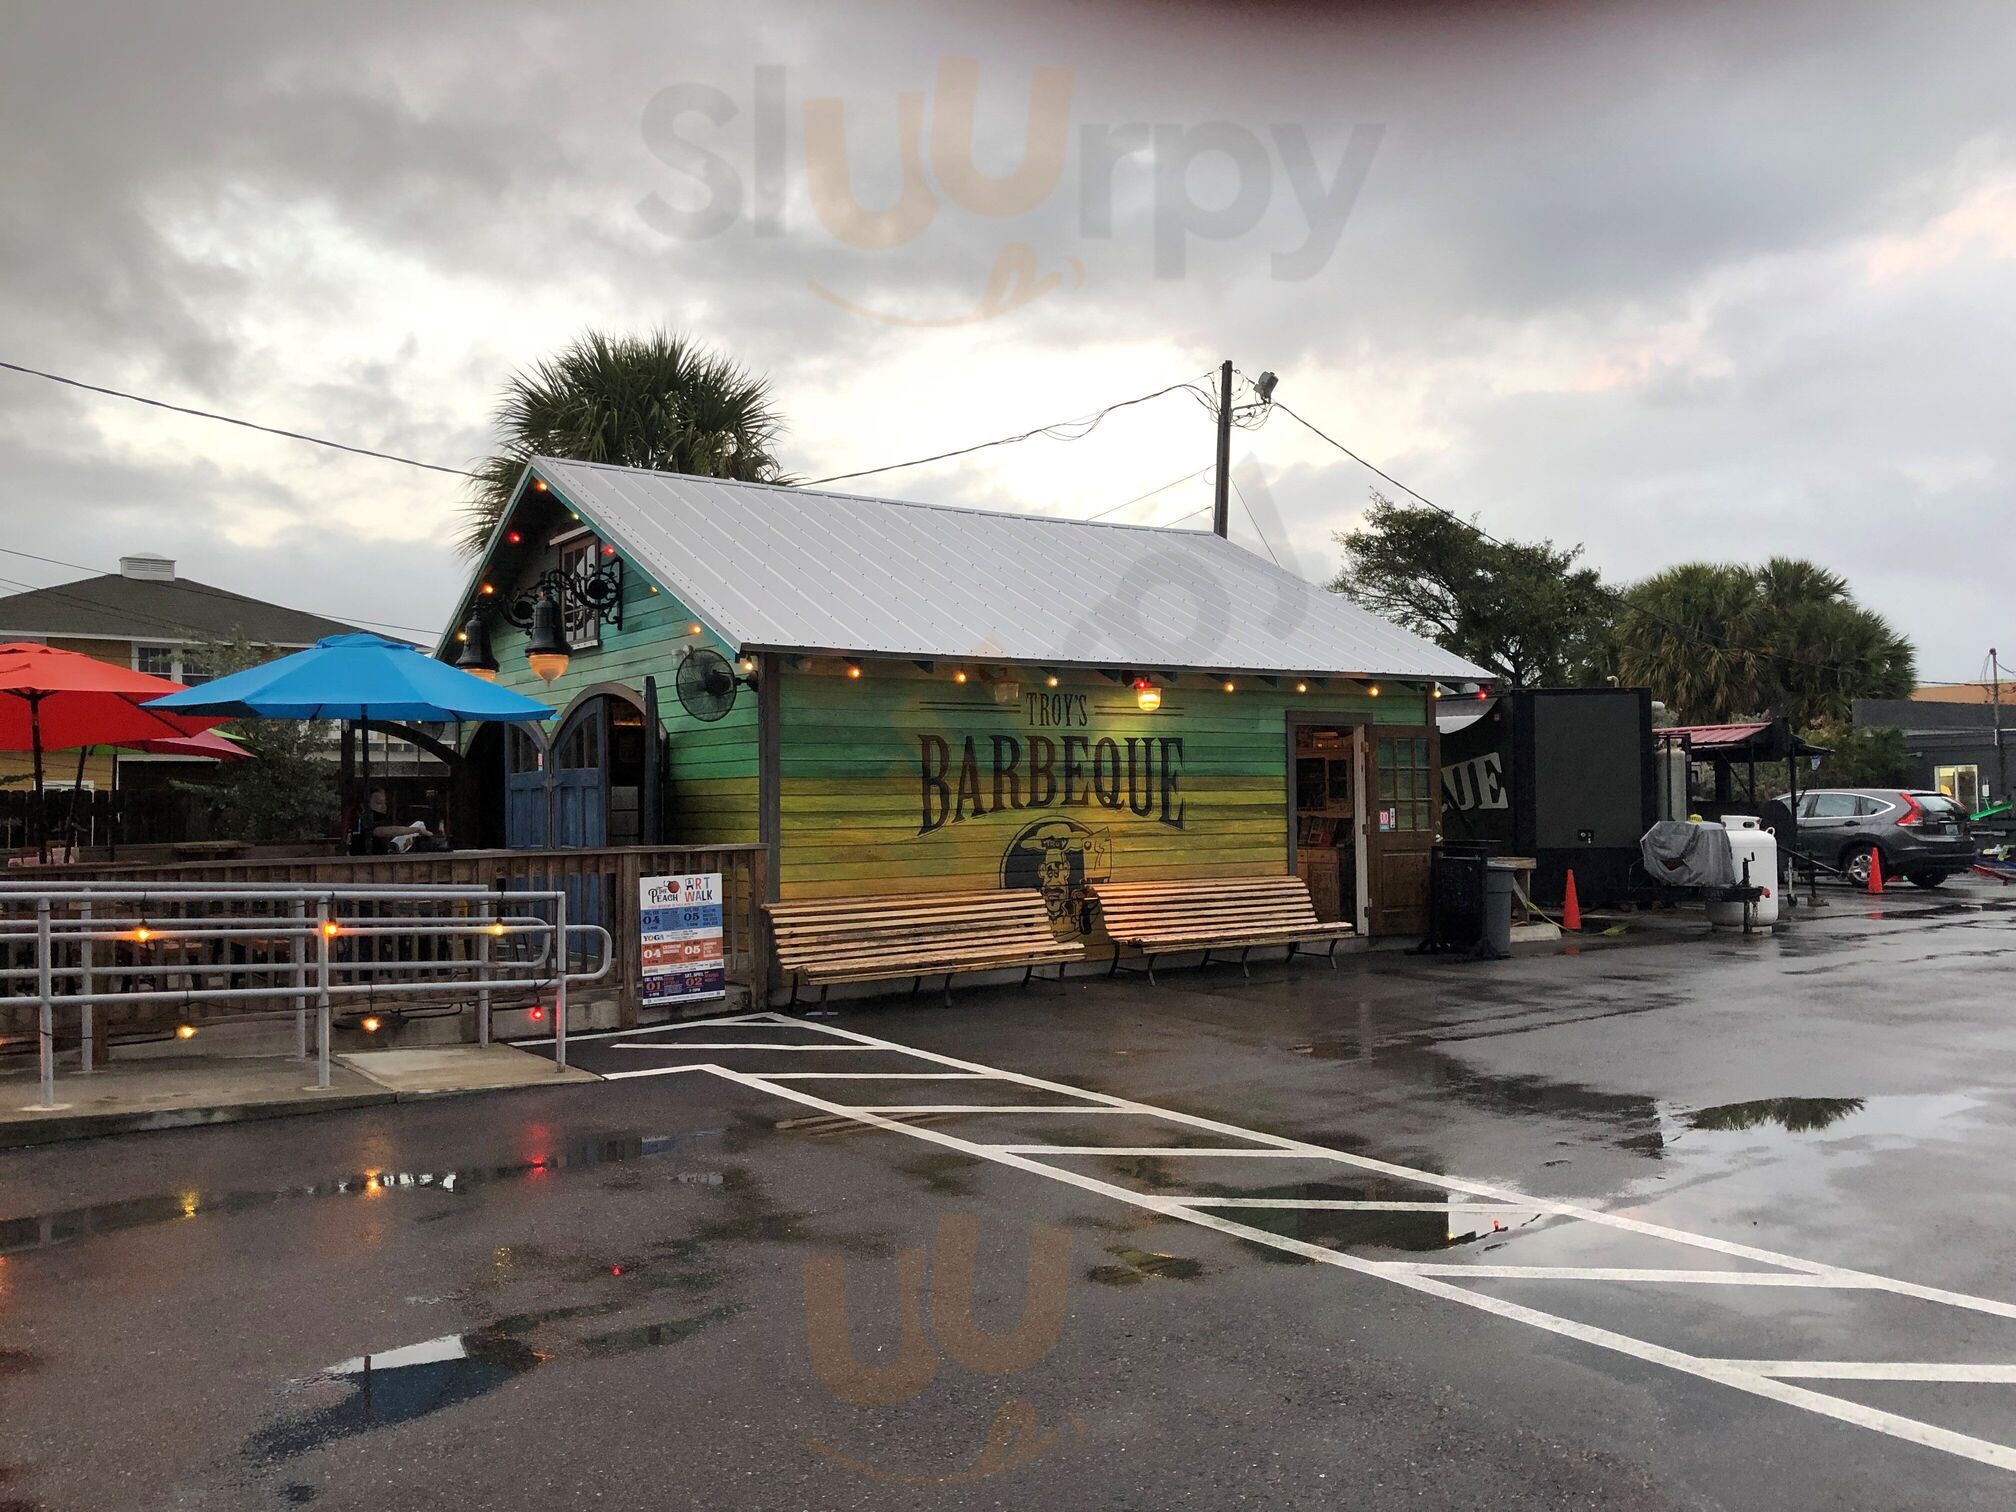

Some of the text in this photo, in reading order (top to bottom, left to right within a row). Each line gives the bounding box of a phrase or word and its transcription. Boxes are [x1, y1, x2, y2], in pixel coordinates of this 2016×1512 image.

[1026, 692, 1088, 727] TROY'S
[917, 734, 1187, 837] BARBEQUE
[685, 877, 710, 890] ART
[684, 889, 713, 902] WALK
[684, 912, 700, 922] 05
[643, 934, 665, 942] YOGA
[646, 982, 661, 991] 01
[685, 977, 703, 987] 02
